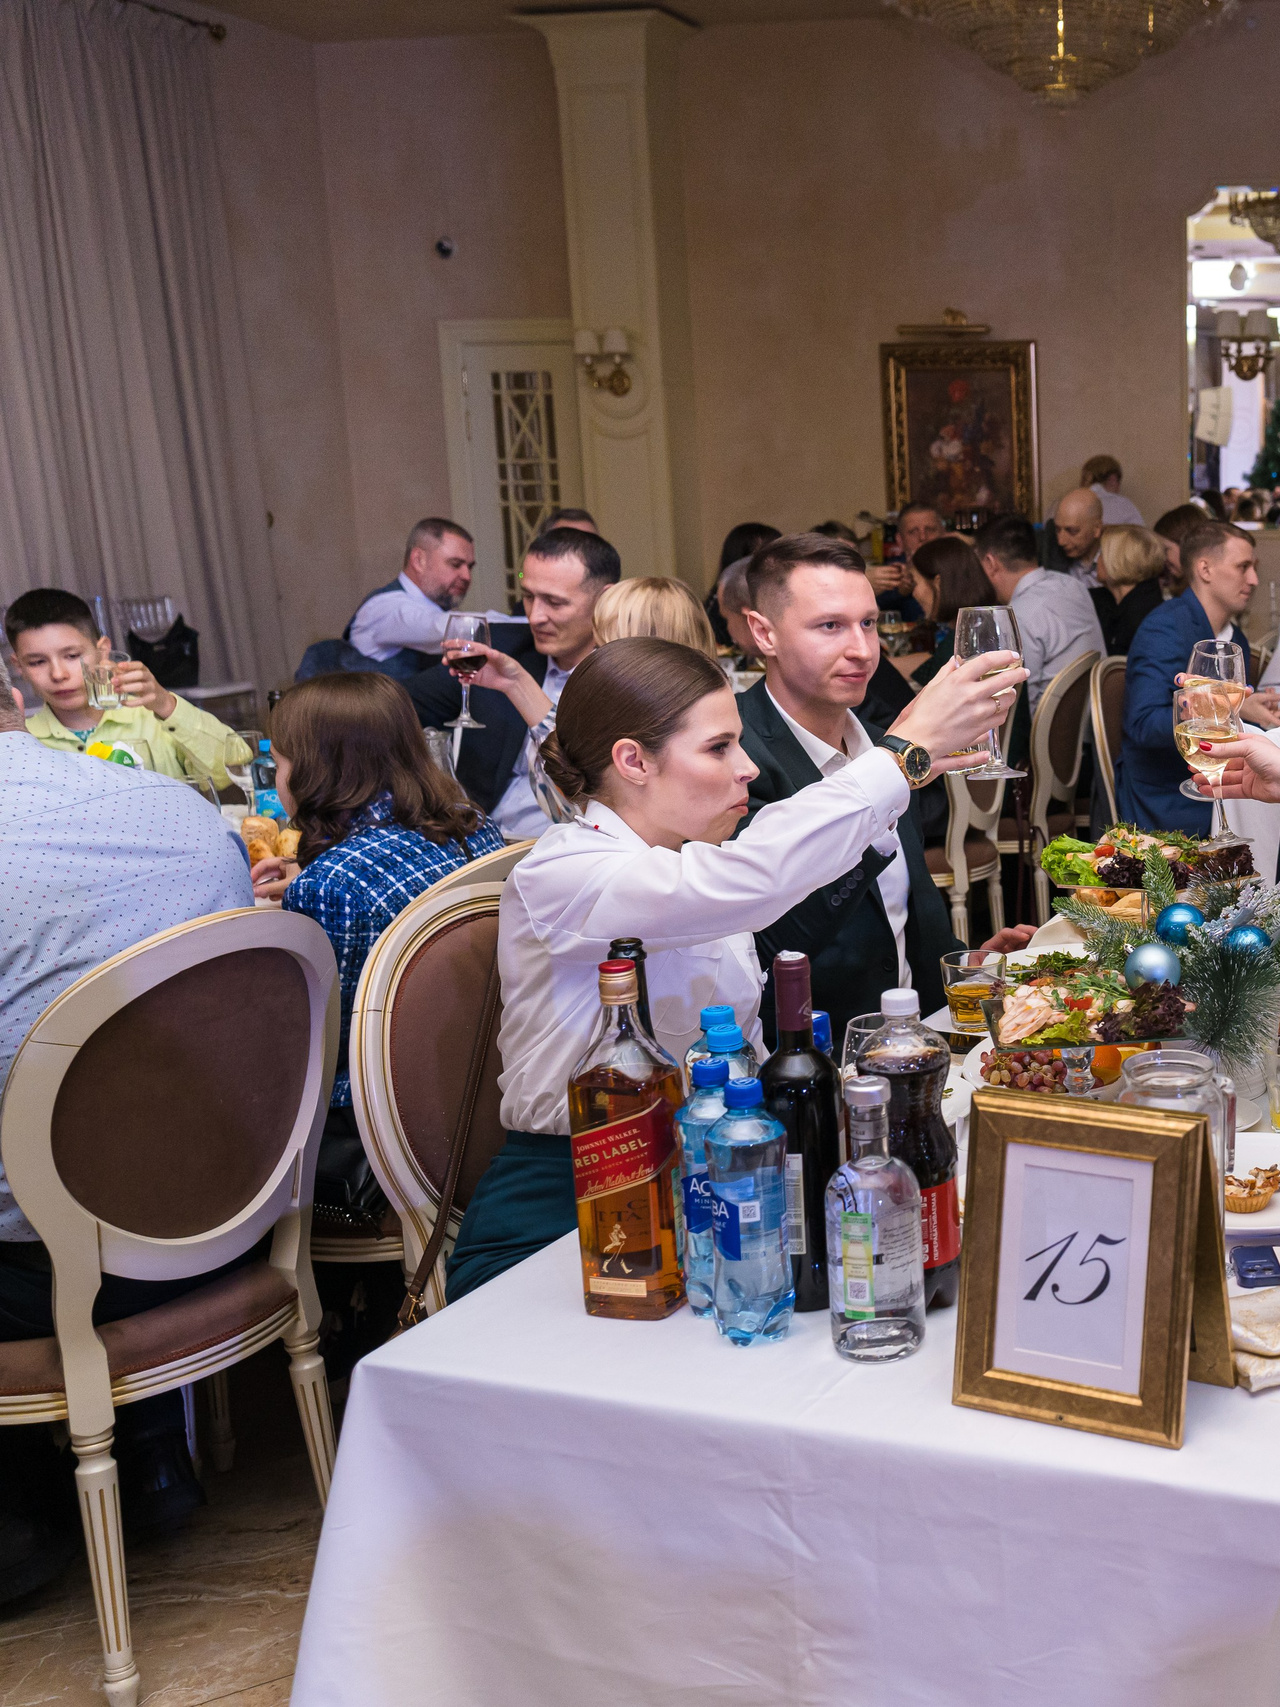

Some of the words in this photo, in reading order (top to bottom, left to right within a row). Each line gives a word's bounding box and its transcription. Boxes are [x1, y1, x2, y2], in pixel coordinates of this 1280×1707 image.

[574, 1153, 600, 1169] RED
[602, 1138, 648, 1160] LABEL
[576, 1138, 606, 1155] JOHNNIE
[689, 1177, 711, 1197] AQ
[931, 1193, 939, 1260] ПЕРЕРАБАТЫВАЕМАЯ
[1022, 1230, 1127, 1306] 15
